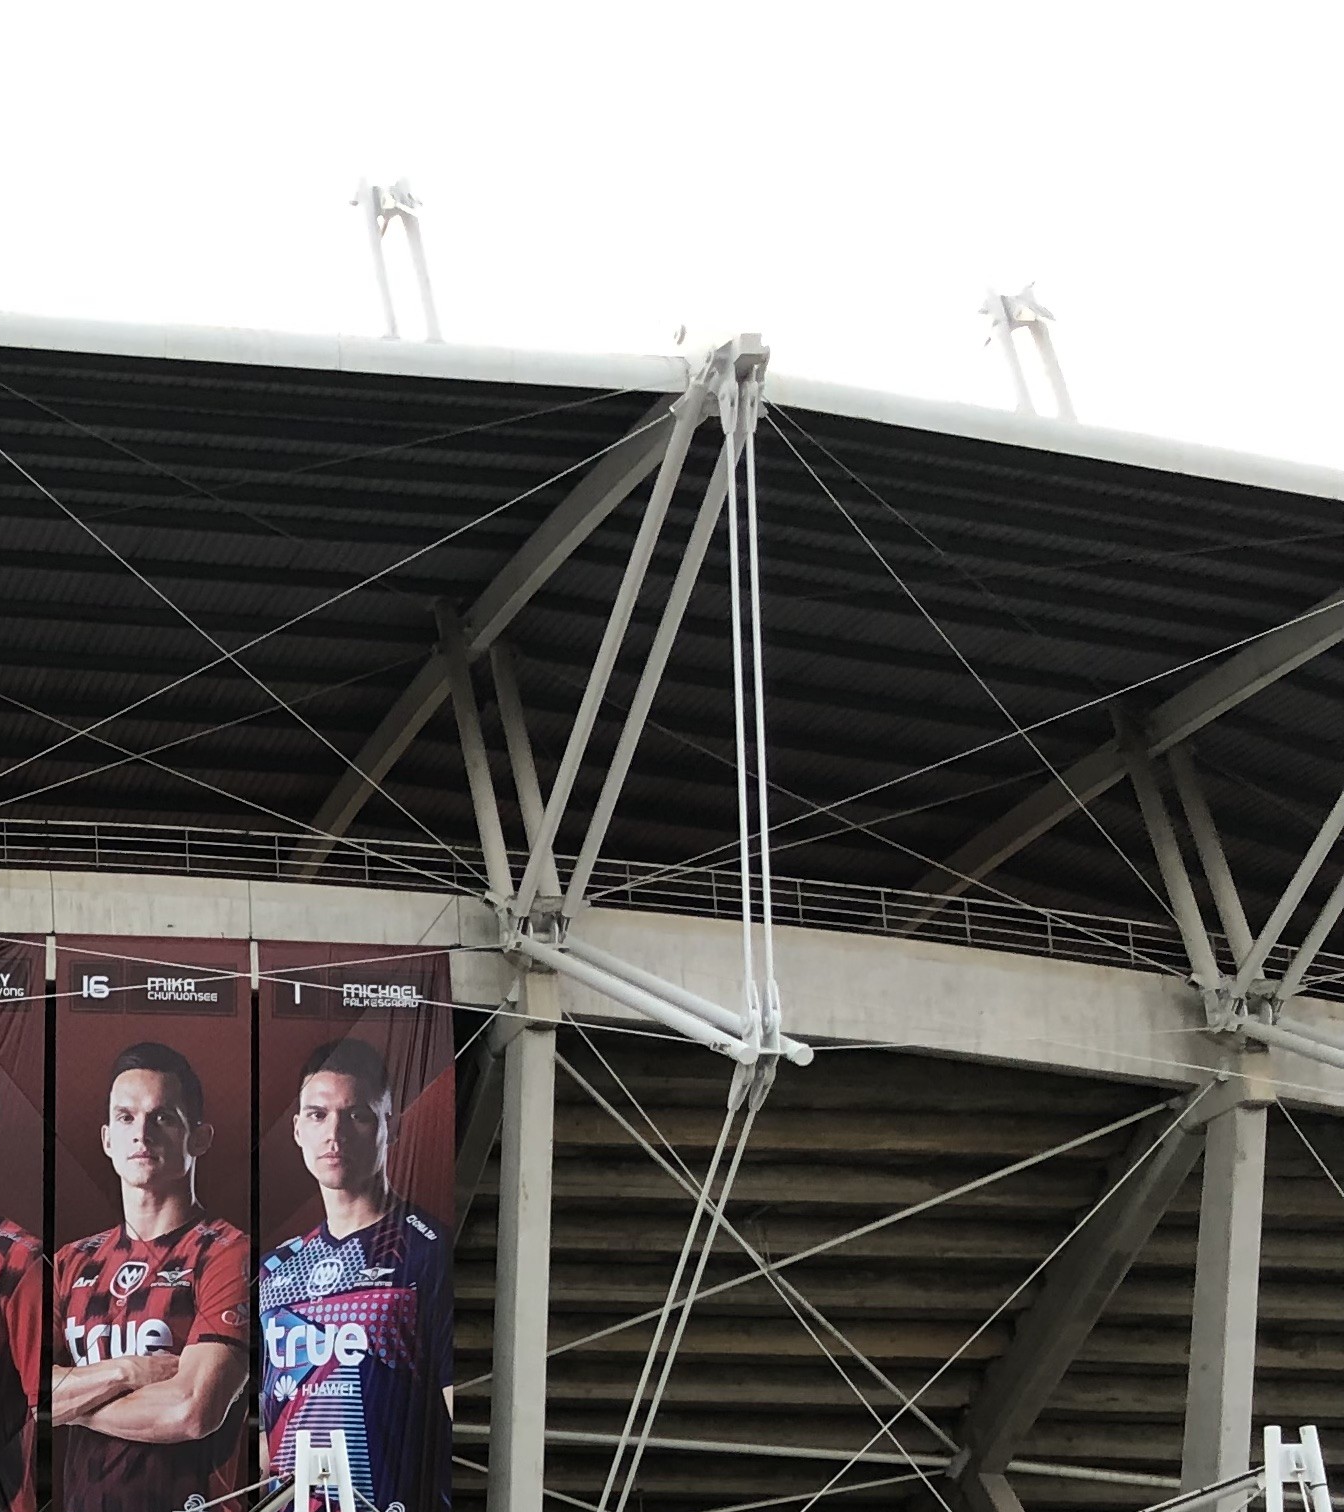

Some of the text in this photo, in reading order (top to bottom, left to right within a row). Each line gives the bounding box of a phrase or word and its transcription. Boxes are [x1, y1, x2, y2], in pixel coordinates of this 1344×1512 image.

[82, 975, 110, 998] 16
[148, 977, 195, 991] MIKA
[343, 984, 422, 999] MICHAEL
[72, 1274, 99, 1289] Ari
[65, 1316, 173, 1367] true
[266, 1317, 368, 1369] true
[302, 1383, 355, 1397] HUAWEI
